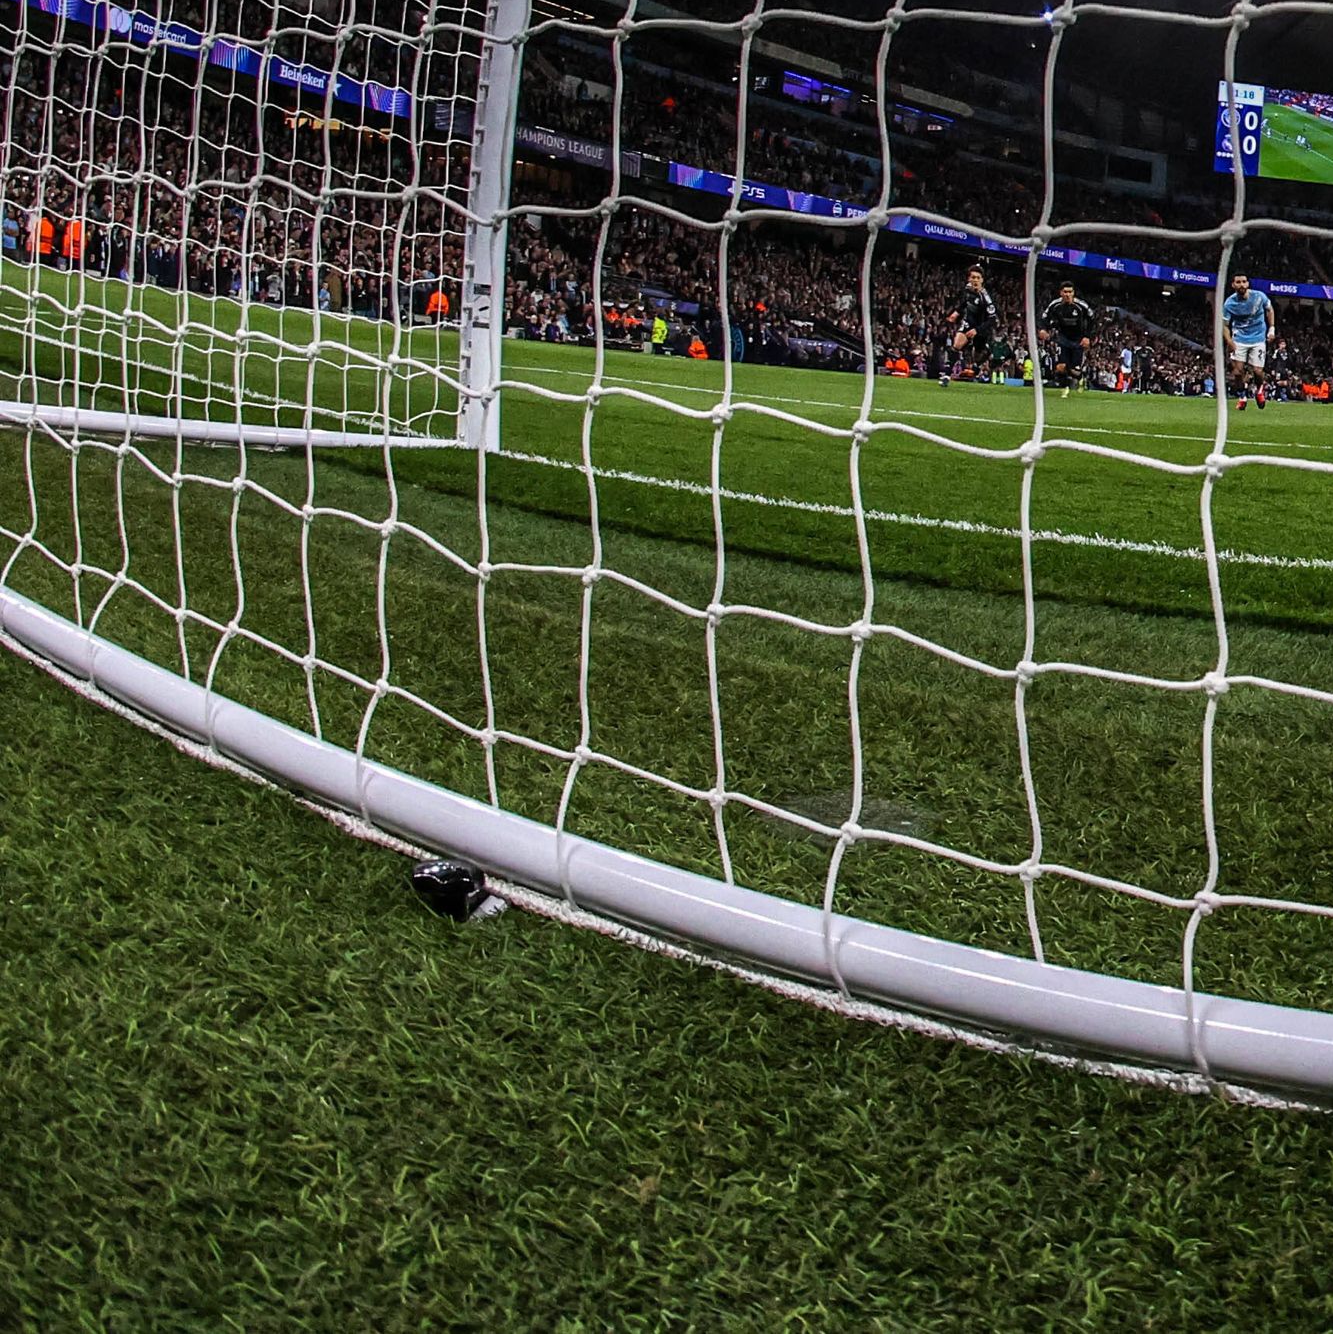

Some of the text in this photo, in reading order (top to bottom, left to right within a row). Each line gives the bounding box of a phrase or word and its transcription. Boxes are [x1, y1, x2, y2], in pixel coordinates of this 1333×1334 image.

[134, 20, 187, 44] masercard
[279, 64, 325, 89] Heineken
[1244, 111, 1259, 131] 0
[568, 140, 605, 160] LEAGUE
[1242, 135, 1257, 155] 0
[1179, 272, 1210, 283] crypto.com
[1270, 283, 1298, 294] bet365
